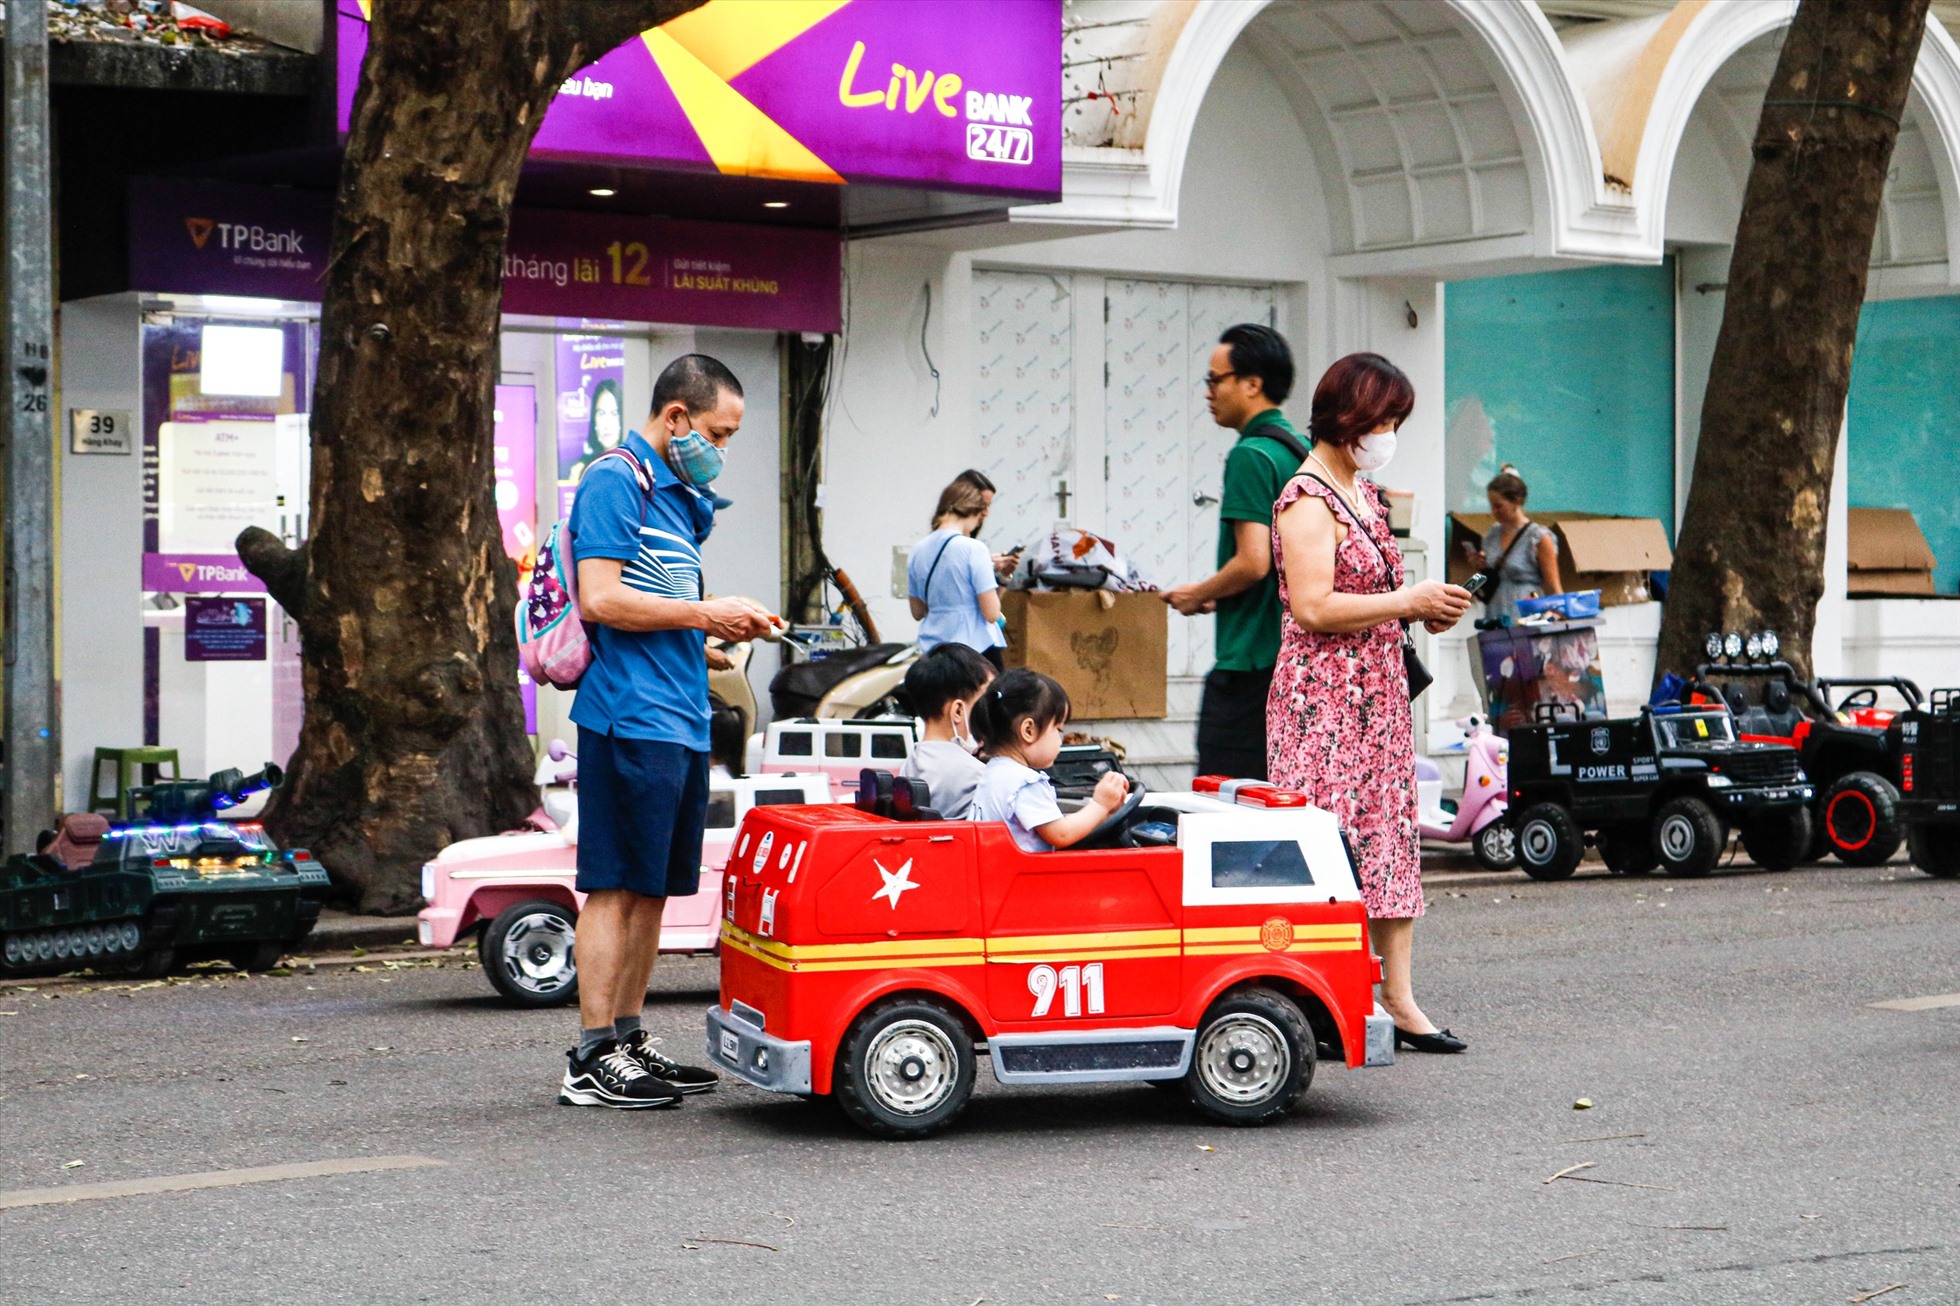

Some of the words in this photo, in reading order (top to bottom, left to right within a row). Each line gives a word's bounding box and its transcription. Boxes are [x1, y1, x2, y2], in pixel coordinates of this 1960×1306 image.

[582, 76, 614, 101] bạn
[839, 40, 963, 118] Live
[965, 90, 1033, 126] BANK
[970, 126, 1029, 161] 24/7
[217, 223, 304, 254] TPBank
[573, 257, 600, 283] lãi
[606, 240, 650, 287] 12
[23, 393, 48, 413] 26
[90, 415, 114, 434] 39
[197, 564, 248, 582] TPBank
[1578, 764, 1626, 779] POWER
[1026, 962, 1105, 1018] 911
